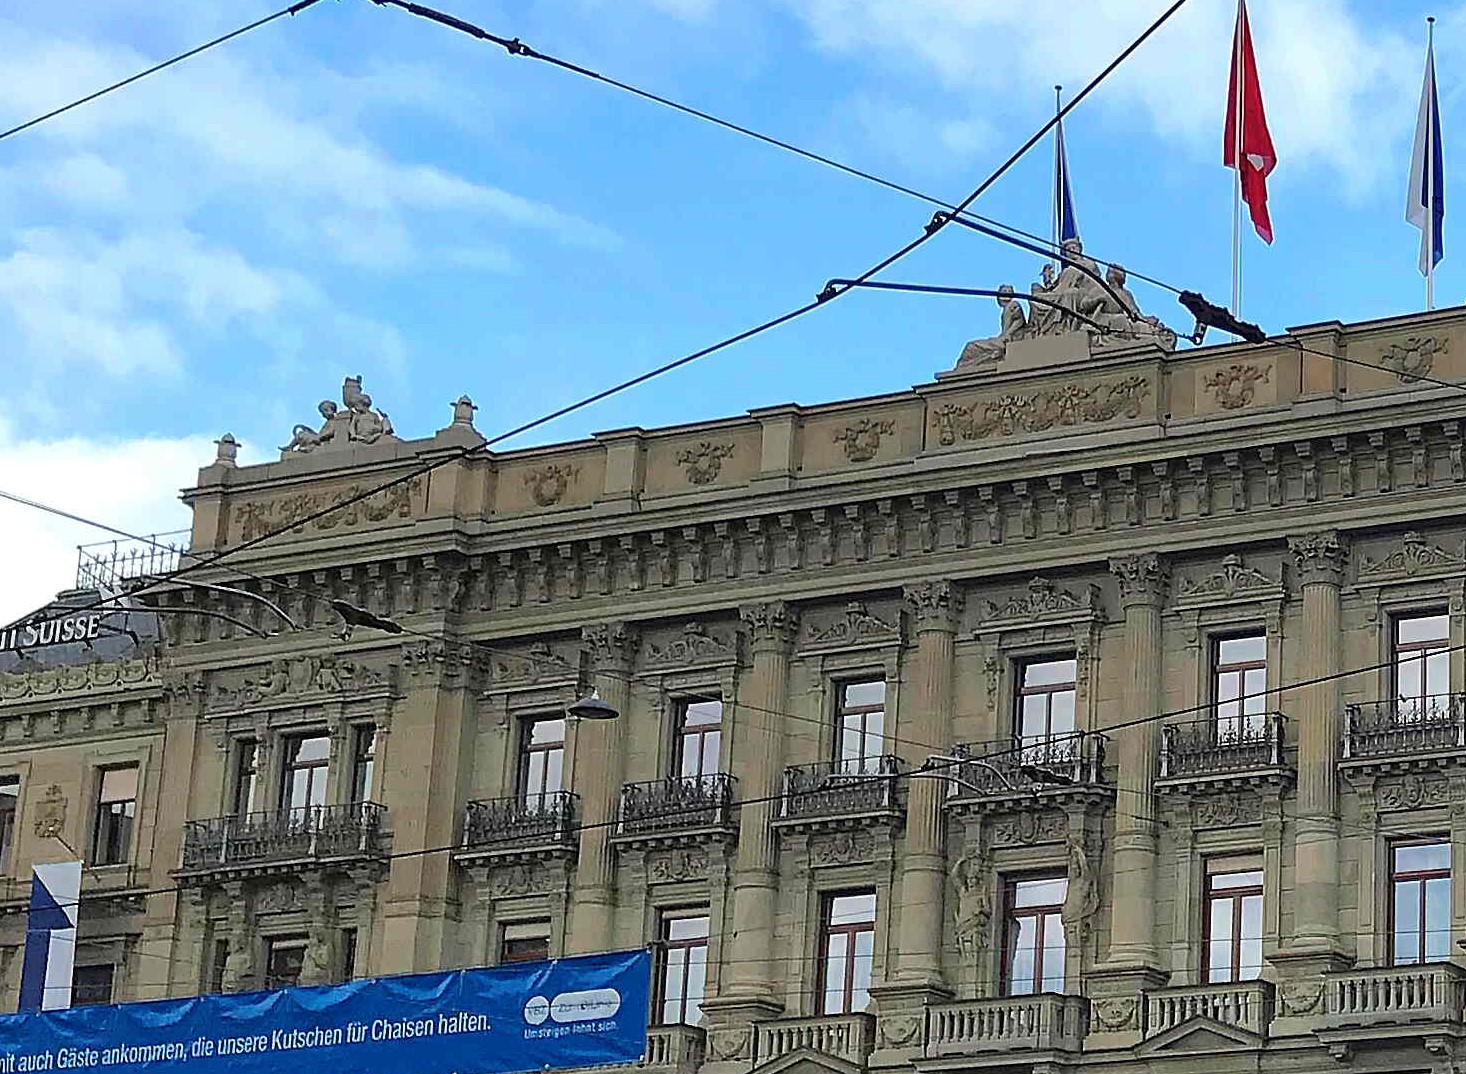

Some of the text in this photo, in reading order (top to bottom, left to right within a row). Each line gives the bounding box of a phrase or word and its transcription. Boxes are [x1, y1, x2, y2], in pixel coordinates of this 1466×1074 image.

[23, 614, 101, 647] SUISSE
[18, 1050, 53, 1072] auch
[57, 1047, 98, 1069] Gäste
[102, 1043, 187, 1065] ankommen,
[192, 1036, 214, 1057] die
[217, 1035, 267, 1056] unsere
[271, 1026, 342, 1050] Kutschen
[346, 1021, 368, 1043] für
[371, 1017, 433, 1042] Chaisen
[438, 1011, 491, 1035] halten.
